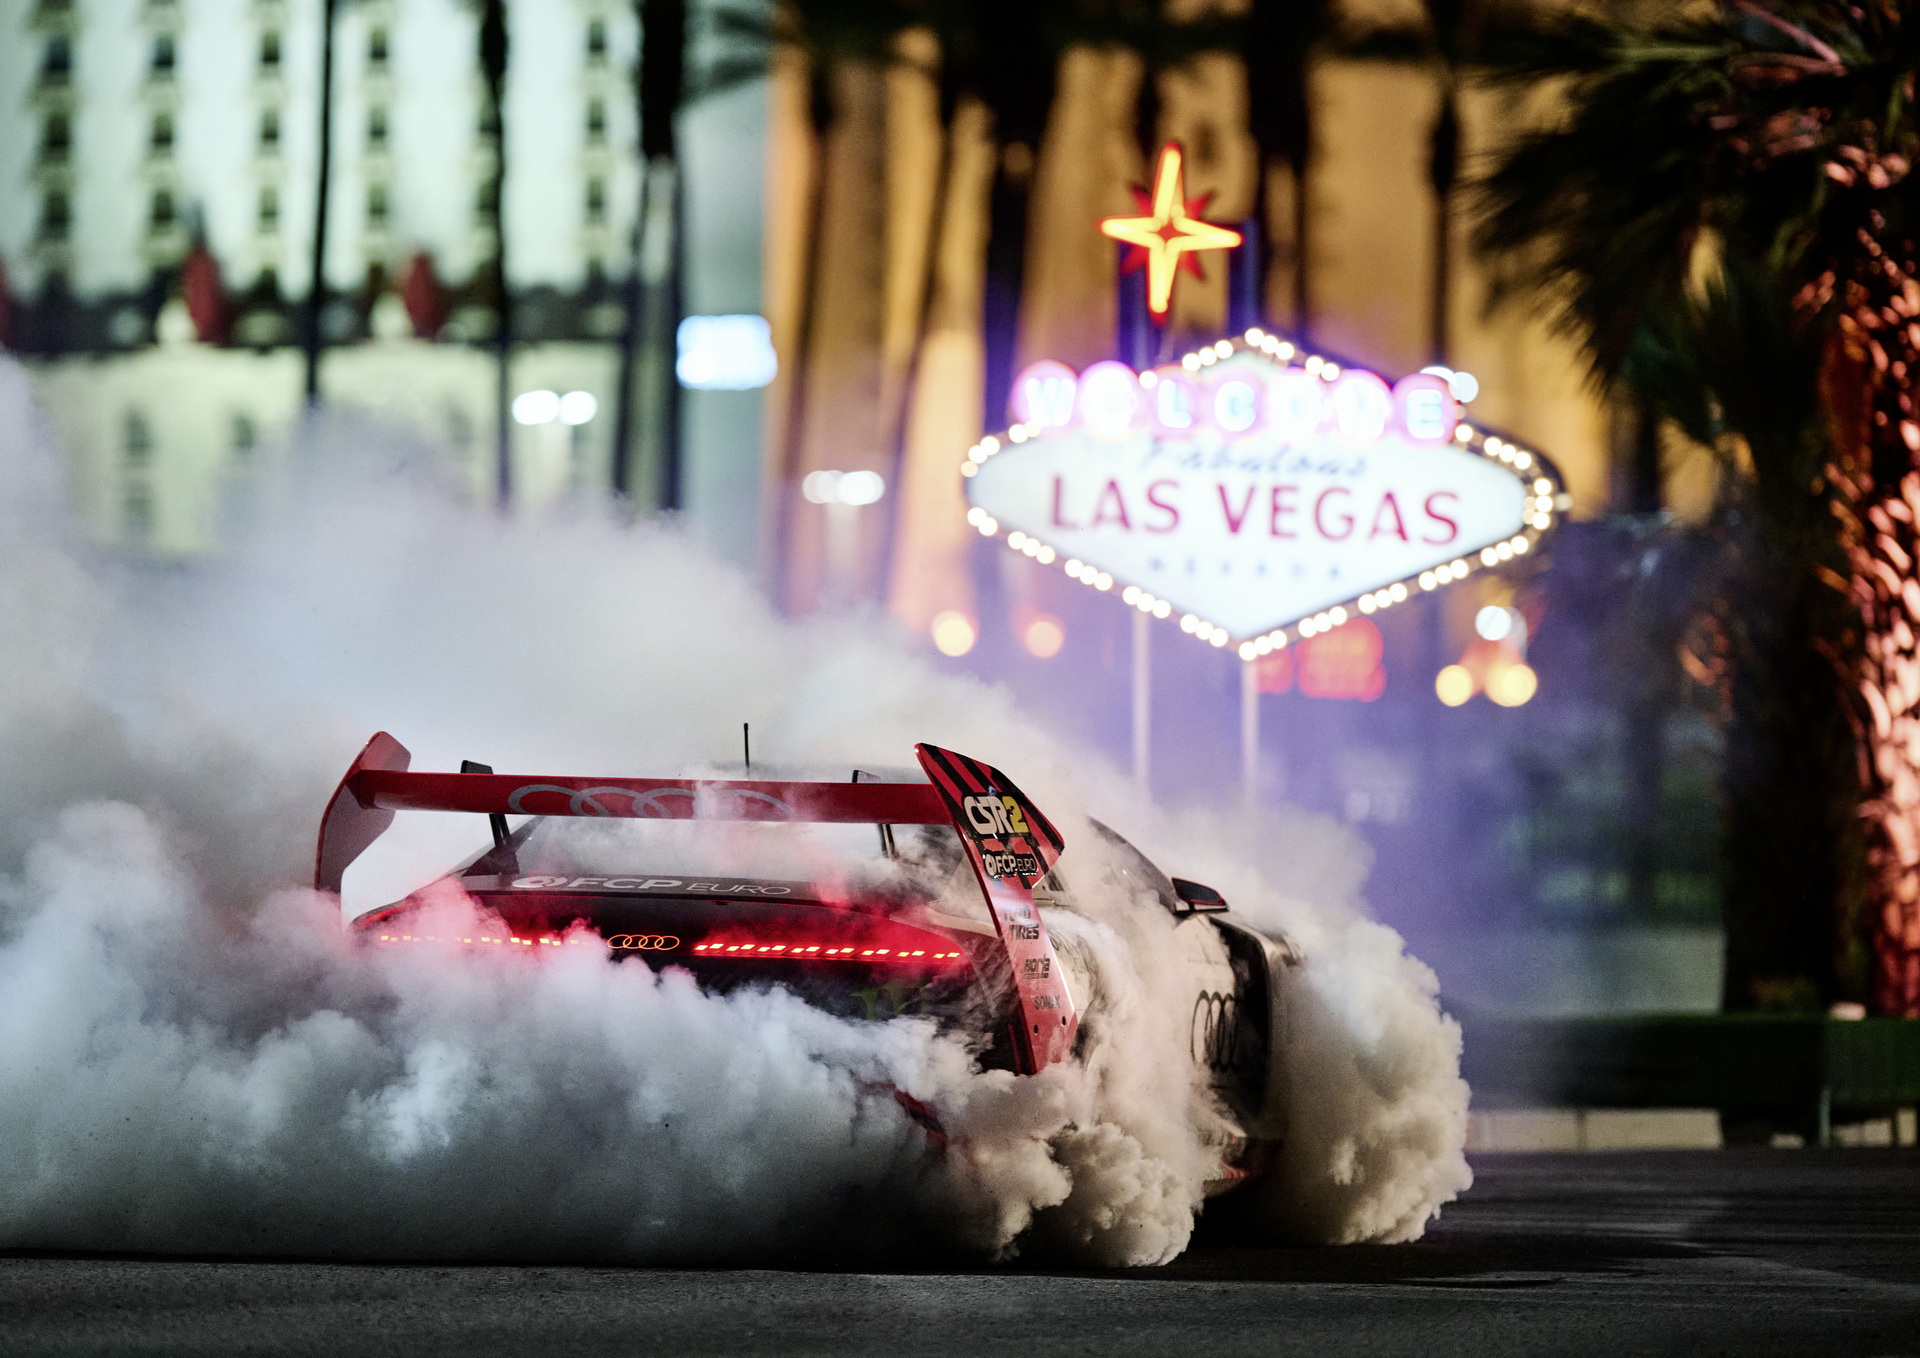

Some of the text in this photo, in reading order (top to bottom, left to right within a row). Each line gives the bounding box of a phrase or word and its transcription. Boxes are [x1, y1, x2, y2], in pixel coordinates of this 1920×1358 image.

[1051, 474, 1461, 546] LAS VEGAS
[964, 796, 1030, 834] CSR2
[995, 855, 1037, 873] FCP EURO
[567, 877, 791, 895] FCP EURO
[1010, 924, 1039, 940] TIRES
